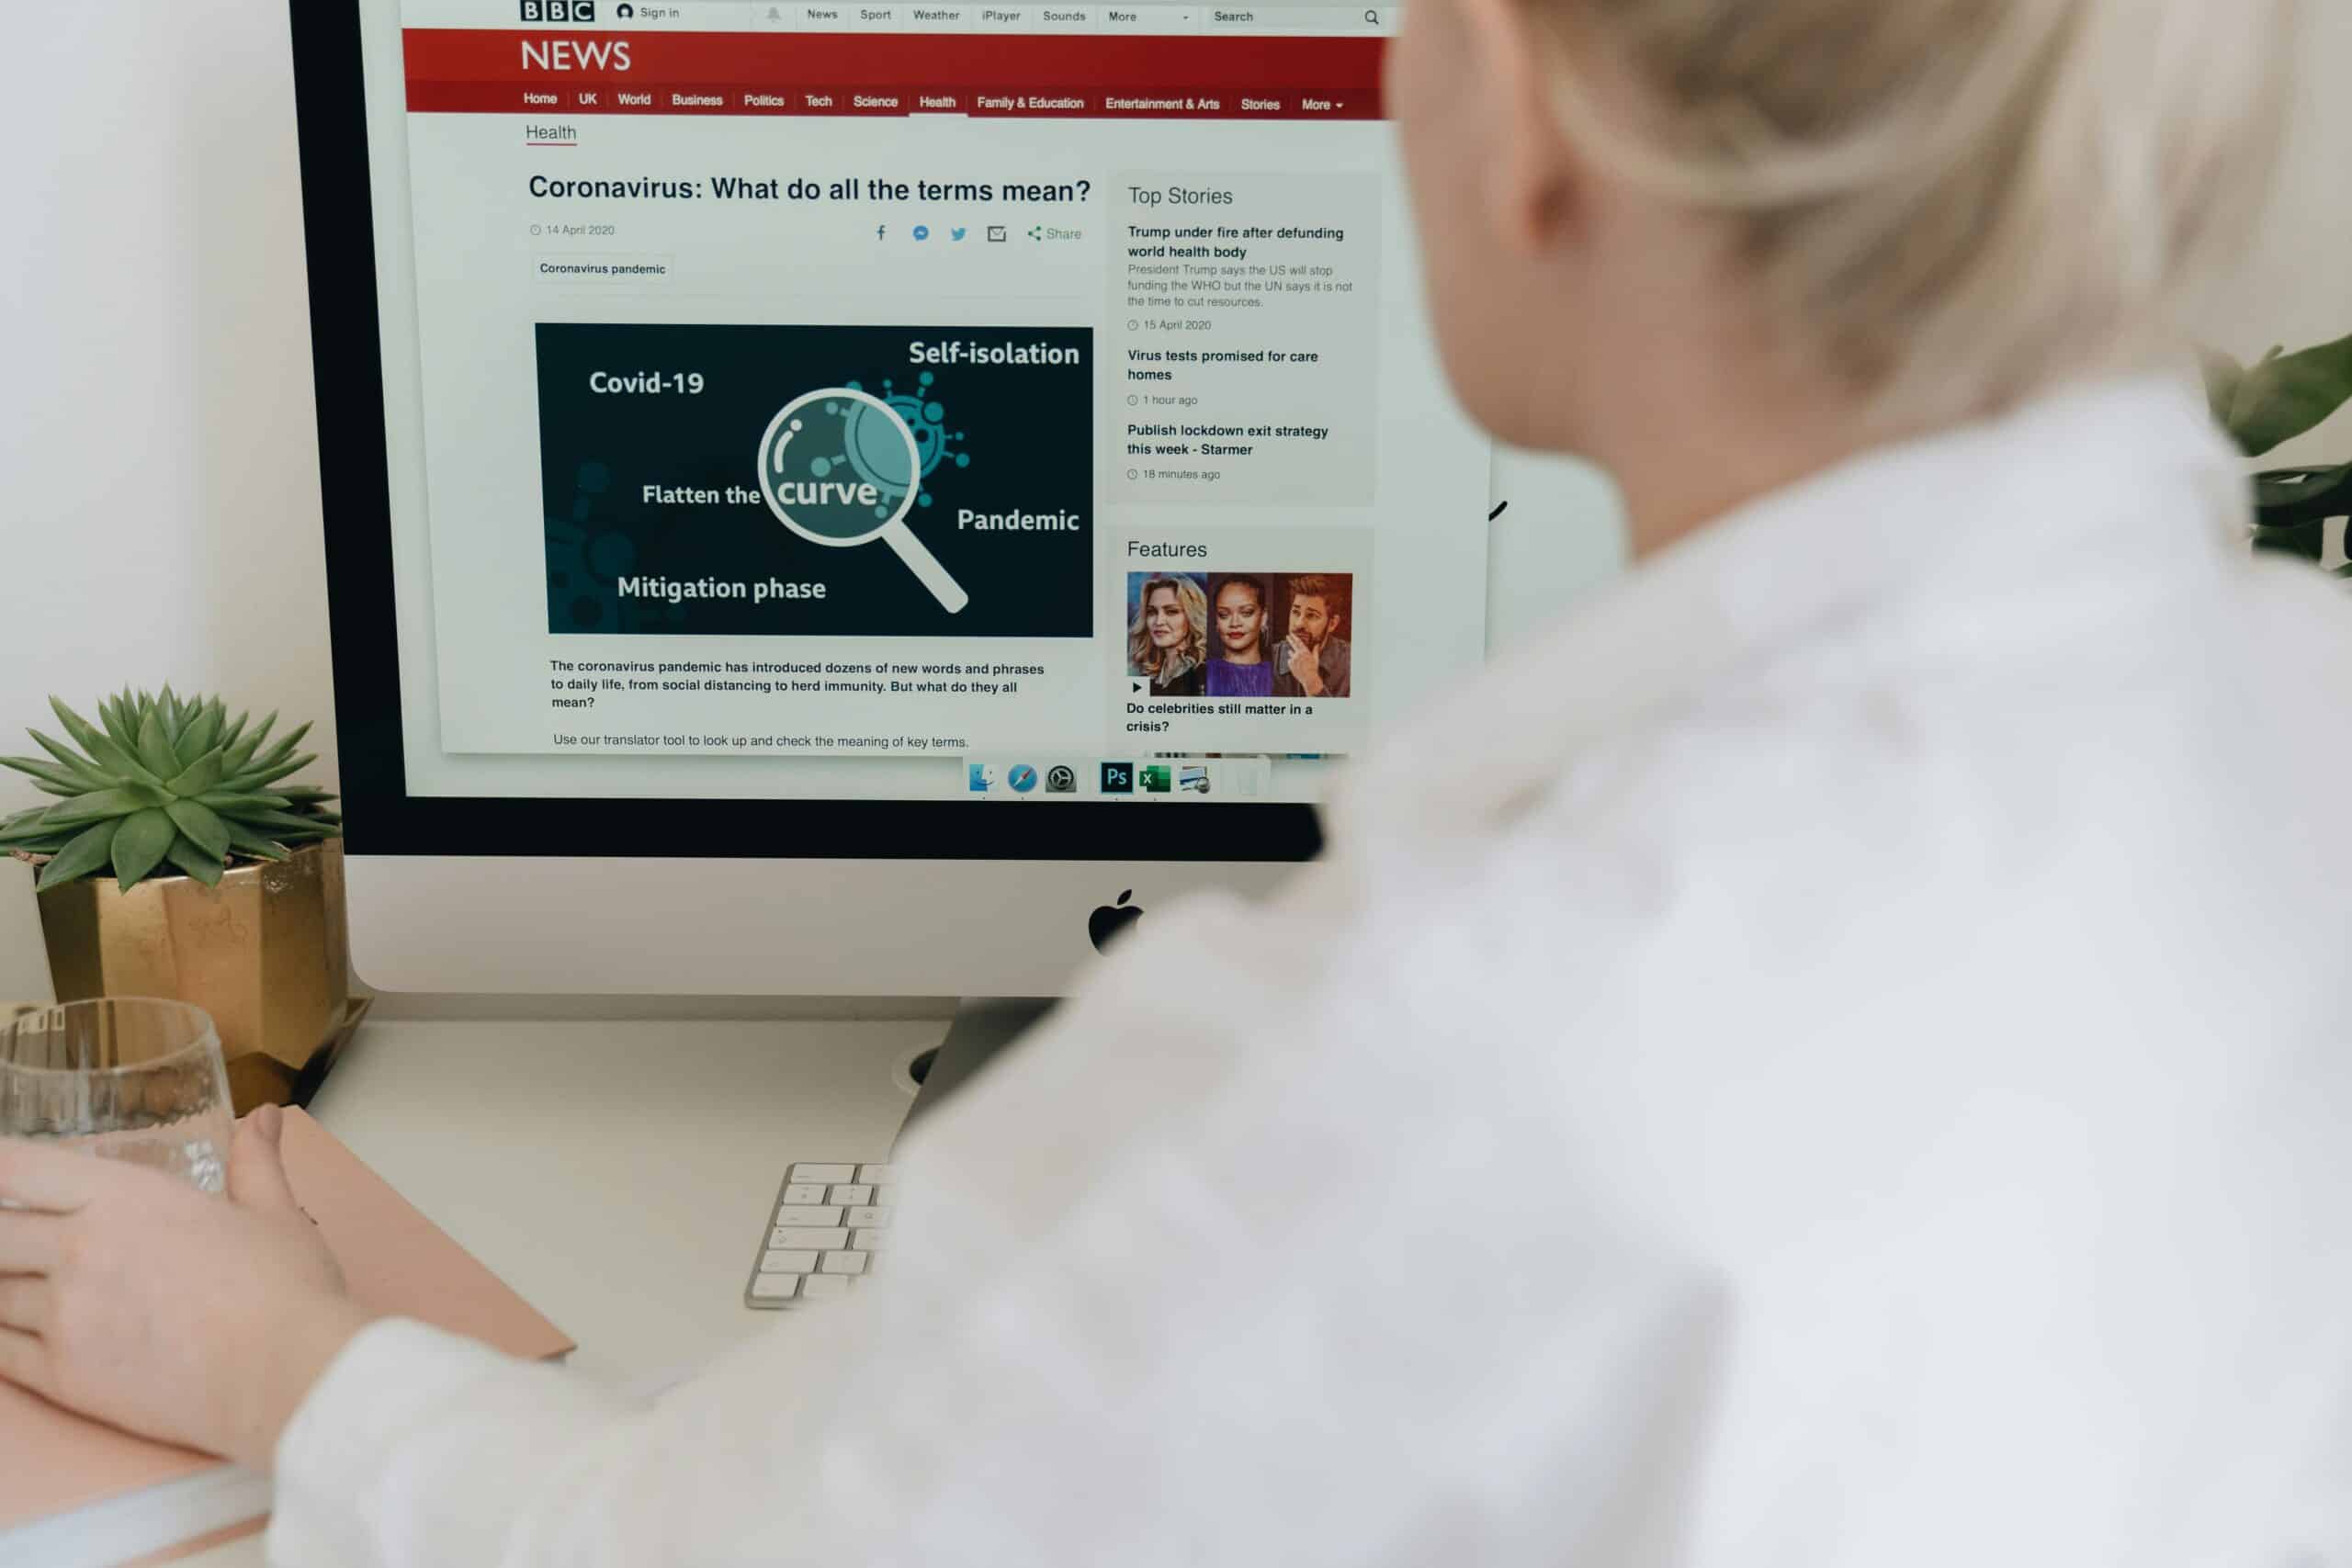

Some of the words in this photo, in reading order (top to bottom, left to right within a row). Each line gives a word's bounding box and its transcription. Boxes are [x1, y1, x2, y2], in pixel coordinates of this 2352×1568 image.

[521, 0, 595, 22] BBC
[640, 6, 666, 21] Sign
[669, 7, 680, 18] in
[808, 8, 839, 19] News
[860, 8, 892, 21] Sport
[912, 9, 961, 20] Weather
[981, 10, 1022, 23] iPlayer
[1043, 10, 1087, 22] Sounds
[1108, 11, 1137, 22] More
[1214, 10, 1254, 23] Search
[521, 39, 631, 72] NEWS
[523, 92, 559, 105] Home
[578, 92, 598, 105] UK
[617, 93, 651, 106] World
[672, 93, 724, 107] Business
[744, 95, 785, 108] Politics
[804, 95, 833, 107] Tech
[853, 95, 899, 109] Science
[918, 95, 956, 109] Health
[977, 96, 1014, 111] Family
[1016, 96, 1026, 109] &
[1028, 96, 1085, 110] Education
[1105, 96, 1183, 111] Entertainment
[1185, 97, 1195, 110] &
[1197, 97, 1221, 110] Arts
[1241, 98, 1283, 111] Stories
[1302, 98, 1331, 111] More
[526, 124, 577, 141] Health
[529, 175, 702, 198] Coronavirus:
[710, 176, 779, 199] What
[787, 178, 821, 201] do
[829, 177, 859, 200] all
[866, 178, 910, 201] the
[917, 179, 993, 201] terms
[1002, 179, 1091, 202] mean?
[1127, 186, 1162, 209] Top
[1168, 186, 1233, 205] Stories
[546, 224, 560, 236] 14
[562, 224, 587, 239] April
[588, 224, 616, 236] 2020
[1046, 227, 1082, 241] Share
[1127, 225, 1171, 241] Trump
[1174, 226, 1214, 238] under
[1216, 226, 1239, 239] fire
[1242, 227, 1273, 239] after
[1276, 227, 1344, 243] defunding
[1127, 245, 1165, 257] world
[1169, 245, 1210, 258] health
[1214, 246, 1248, 261] body
[539, 263, 609, 274] Coronavirus
[611, 264, 666, 276] pandemic
[1127, 264, 1180, 275] President
[1183, 265, 1217, 277] Trump
[1220, 265, 1246, 277] says
[1249, 265, 1266, 276] the
[1269, 265, 1286, 276] US
[1289, 265, 1306, 276] will
[1309, 265, 1333, 278] stop
[1127, 279, 1168, 293] funding
[1170, 280, 1189, 291] the
[1191, 280, 1221, 291] WHO
[1224, 281, 1242, 292] but
[1244, 281, 1261, 292] the
[1264, 281, 1283, 292] UN
[1285, 283, 1311, 295] says
[1313, 281, 1321, 292] it
[1323, 281, 1333, 292] is
[1335, 281, 1353, 292] not
[1127, 296, 1145, 307] the
[1148, 296, 1171, 307] time
[1173, 297, 1184, 308] to
[1187, 297, 1204, 308] cut
[1206, 299, 1264, 309] resources.
[1144, 320, 1156, 331] 15
[1159, 320, 1182, 333] April
[1185, 320, 1212, 331] 2020
[909, 341, 1080, 365] Self-isolation
[1127, 349, 1162, 361] Virus
[1165, 350, 1198, 362] tests
[1201, 349, 1264, 365] promised
[1268, 350, 1287, 362] for
[1289, 353, 1319, 363] care
[589, 370, 705, 394] Covid-19
[1127, 368, 1172, 381] homes
[1151, 395, 1176, 405] hour
[1178, 396, 1199, 408] ago
[1127, 423, 1177, 436] Publish
[1181, 424, 1244, 437] lockdown
[1247, 425, 1272, 437] exit
[1274, 425, 1329, 440] strategy
[1126, 443, 1152, 456] this
[1155, 443, 1189, 455] week
[1201, 443, 1254, 456] Starmer
[1143, 469, 1156, 479] 18
[1158, 469, 1199, 479] minutes
[1201, 470, 1221, 482] ago
[642, 484, 720, 505] Flatten
[725, 484, 761, 505] the
[777, 479, 878, 506] curve
[957, 508, 1080, 531] Pandemic
[1127, 540, 1208, 558] Features
[617, 575, 747, 604] Mitigation
[753, 576, 827, 605] phase
[549, 660, 574, 671] The
[577, 660, 655, 672] coronavirus
[658, 660, 722, 675] pandemic
[725, 660, 749, 673] has
[752, 661, 821, 674] introduced
[825, 662, 872, 674] dozens
[875, 662, 888, 674] of
[891, 664, 919, 674] new
[922, 663, 962, 675] words
[965, 663, 989, 674] and
[992, 663, 1045, 677] phrases
[550, 679, 564, 690] to
[567, 678, 598, 693] daily
[602, 678, 626, 692] life,
[628, 679, 659, 691] from
[661, 679, 701, 691] social
[704, 679, 772, 694] distancing
[775, 682, 788, 693] to
[791, 680, 820, 692] herd
[824, 680, 887, 694] immunity.
[890, 681, 913, 692] But
[916, 682, 947, 693] what
[950, 681, 967, 693] do
[970, 681, 999, 695] they
[1001, 682, 1017, 693] all
[551, 696, 595, 708] mean?
[1126, 702, 1145, 714] Do
[1148, 703, 1215, 714] celebrities
[1217, 703, 1241, 715] still
[1245, 704, 1287, 715] matter
[1289, 703, 1302, 716] in
[1305, 705, 1313, 716] a
[1125, 720, 1170, 732] crisis?
[553, 734, 578, 745] Use
[580, 736, 601, 746] our
[603, 734, 661, 748] translator
[662, 734, 685, 746] tool
[688, 735, 700, 746] to
[703, 734, 729, 747] look
[731, 737, 748, 750] up
[750, 735, 773, 747] and
[775, 735, 811, 748] check
[815, 736, 834, 748] the
[837, 734, 890, 750] meaning
[891, 736, 905, 750] of
[907, 734, 929, 750] key
[932, 737, 969, 748] terms.
[1107, 767, 1127, 785] Ps
